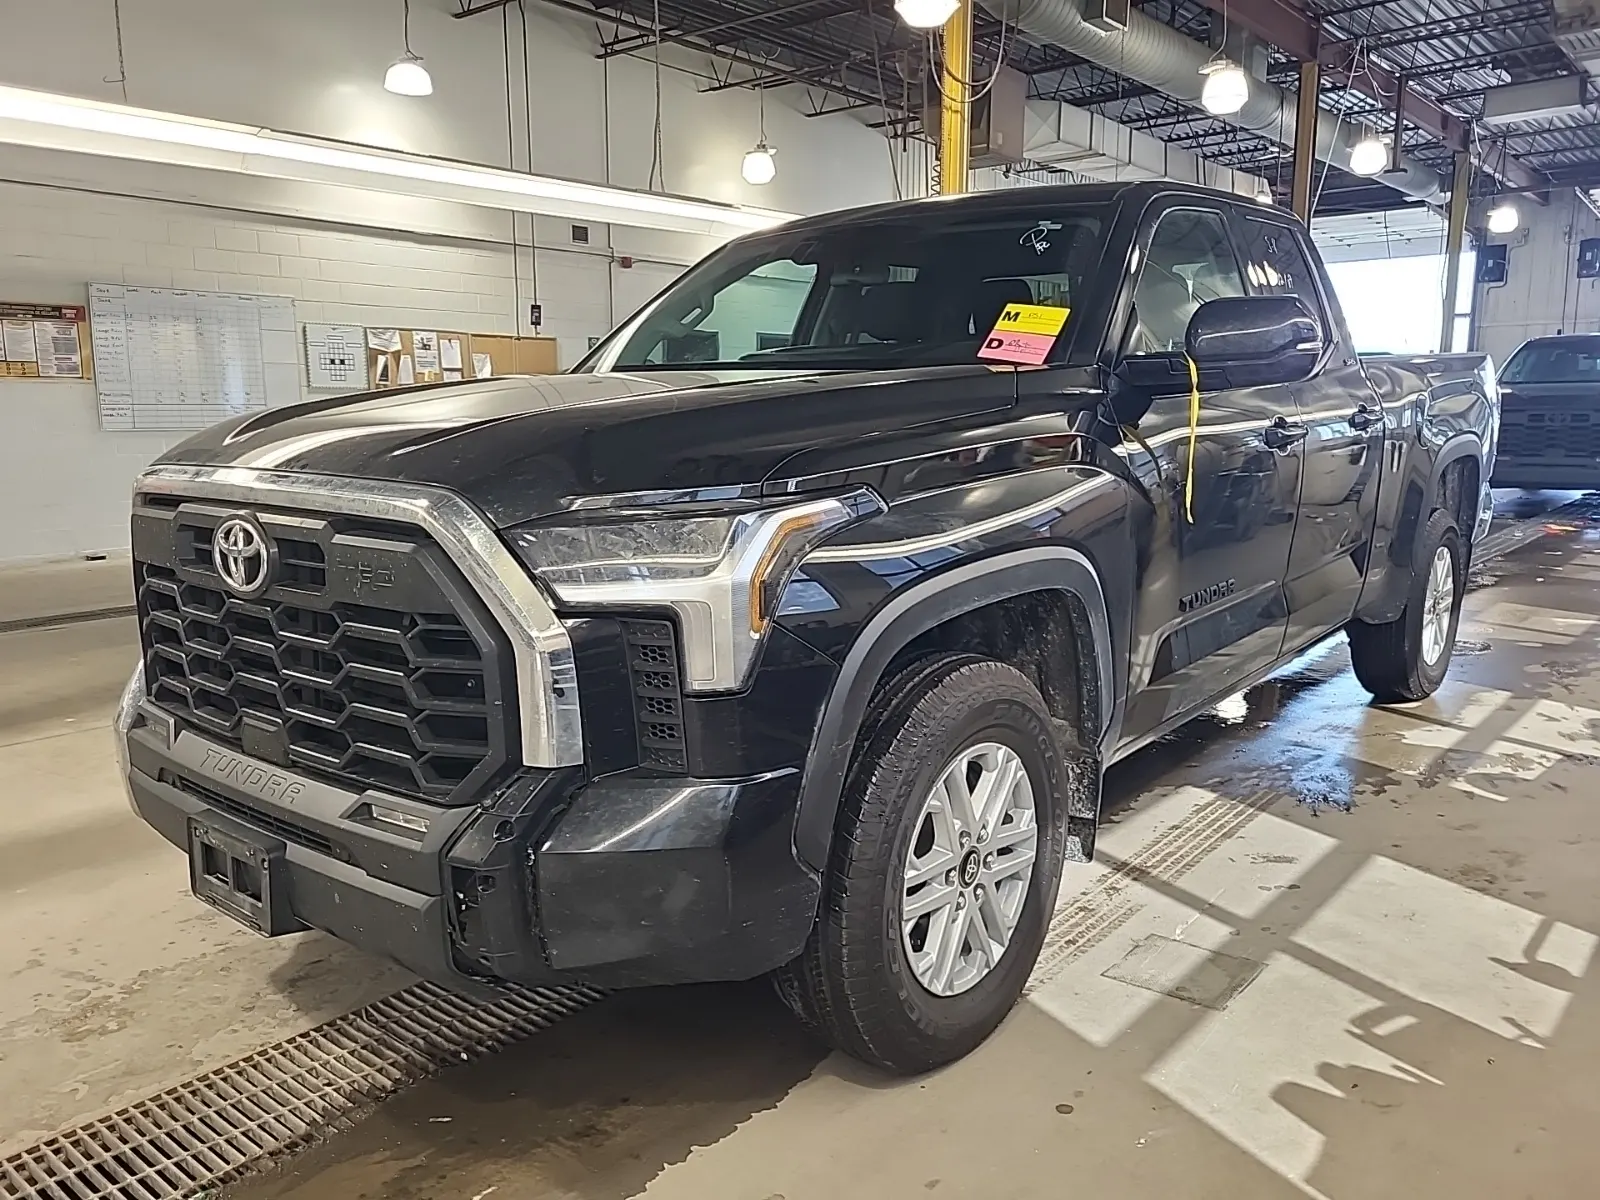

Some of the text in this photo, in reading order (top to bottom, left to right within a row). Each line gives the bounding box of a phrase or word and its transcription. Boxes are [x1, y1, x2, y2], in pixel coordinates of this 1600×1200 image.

[1001, 311, 1021, 322] M
[985, 338, 1004, 349] D
[1179, 578, 1236, 612] TUNDRA
[200, 748, 306, 804] TUNDRA
